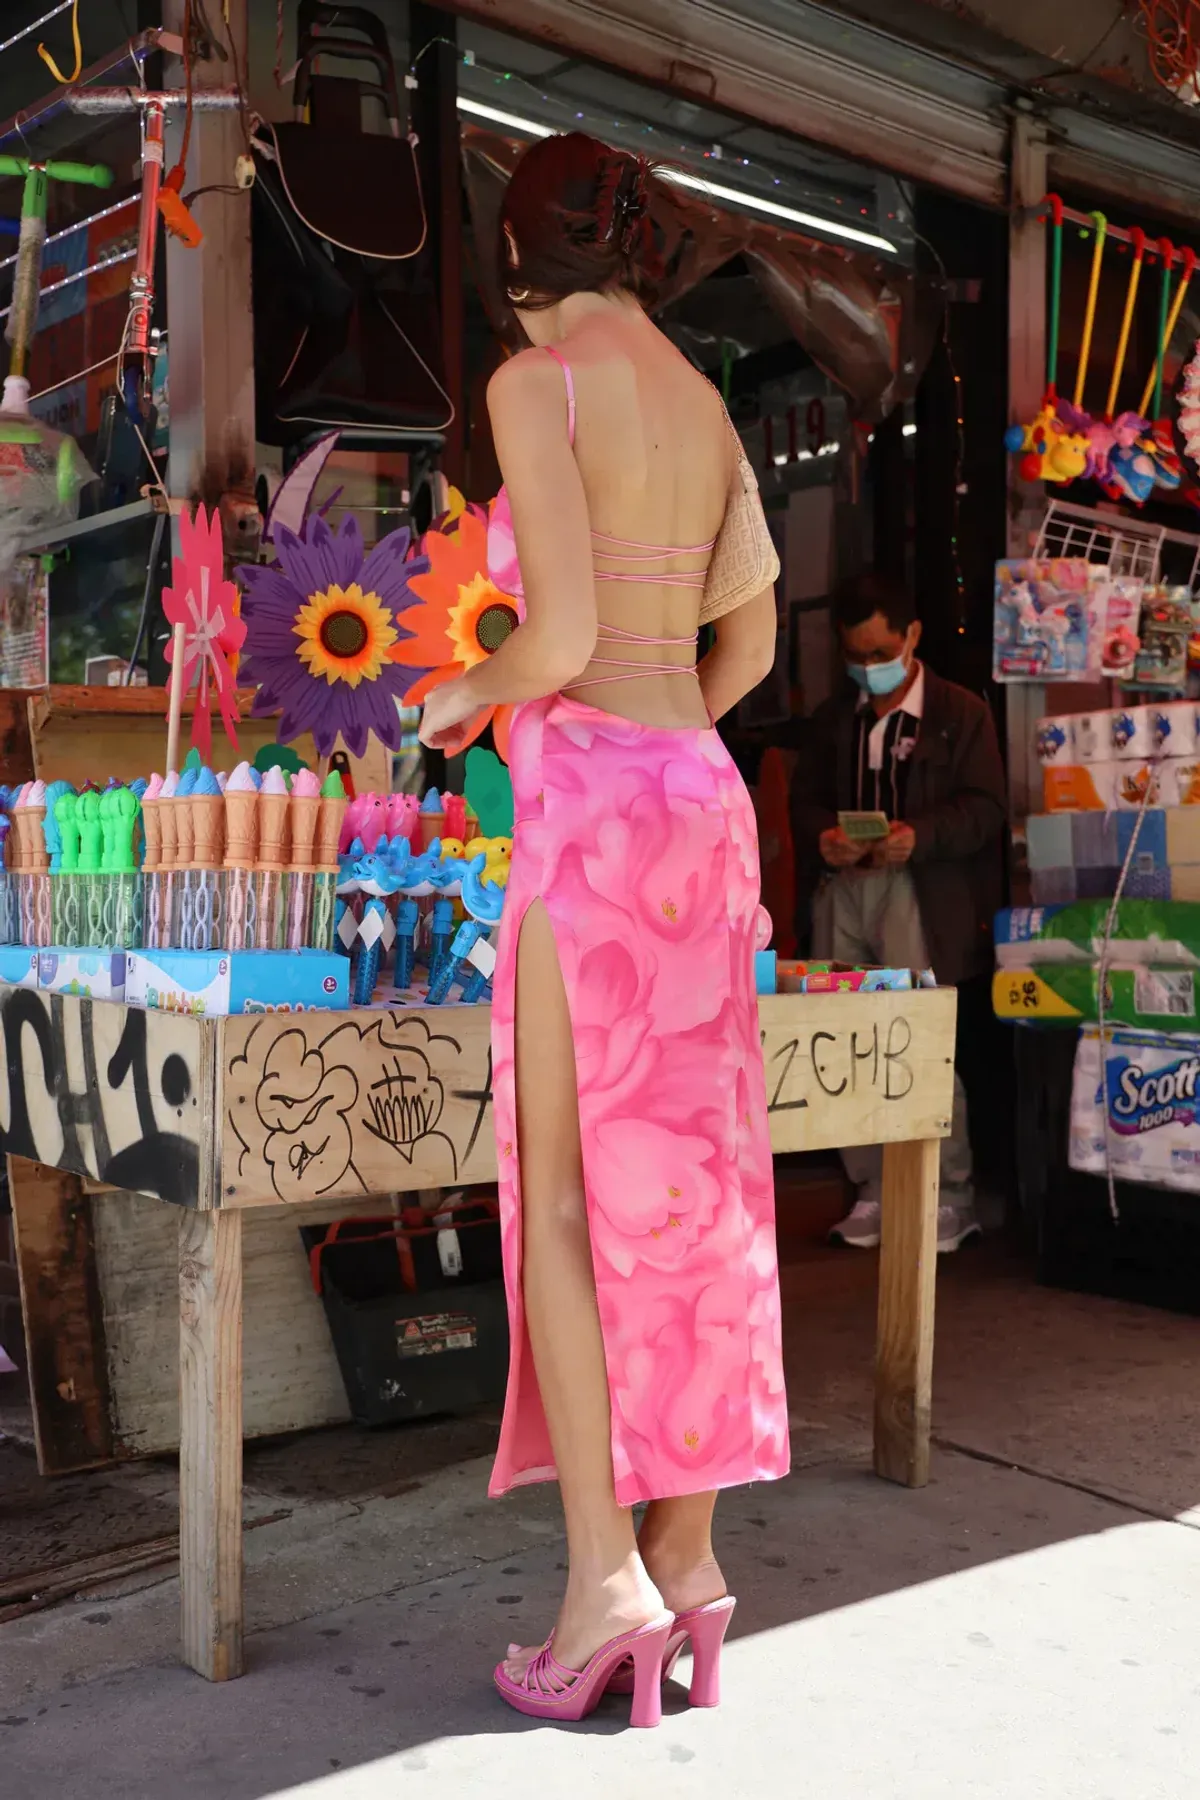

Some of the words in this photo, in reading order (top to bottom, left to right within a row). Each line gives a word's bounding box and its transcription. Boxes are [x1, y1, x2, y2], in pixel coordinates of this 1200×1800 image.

[763, 398, 826, 469] 119
[1022, 980, 1038, 1008] 26
[1114, 1057, 1200, 1114] Scott
[1139, 1106, 1173, 1131] 1000
